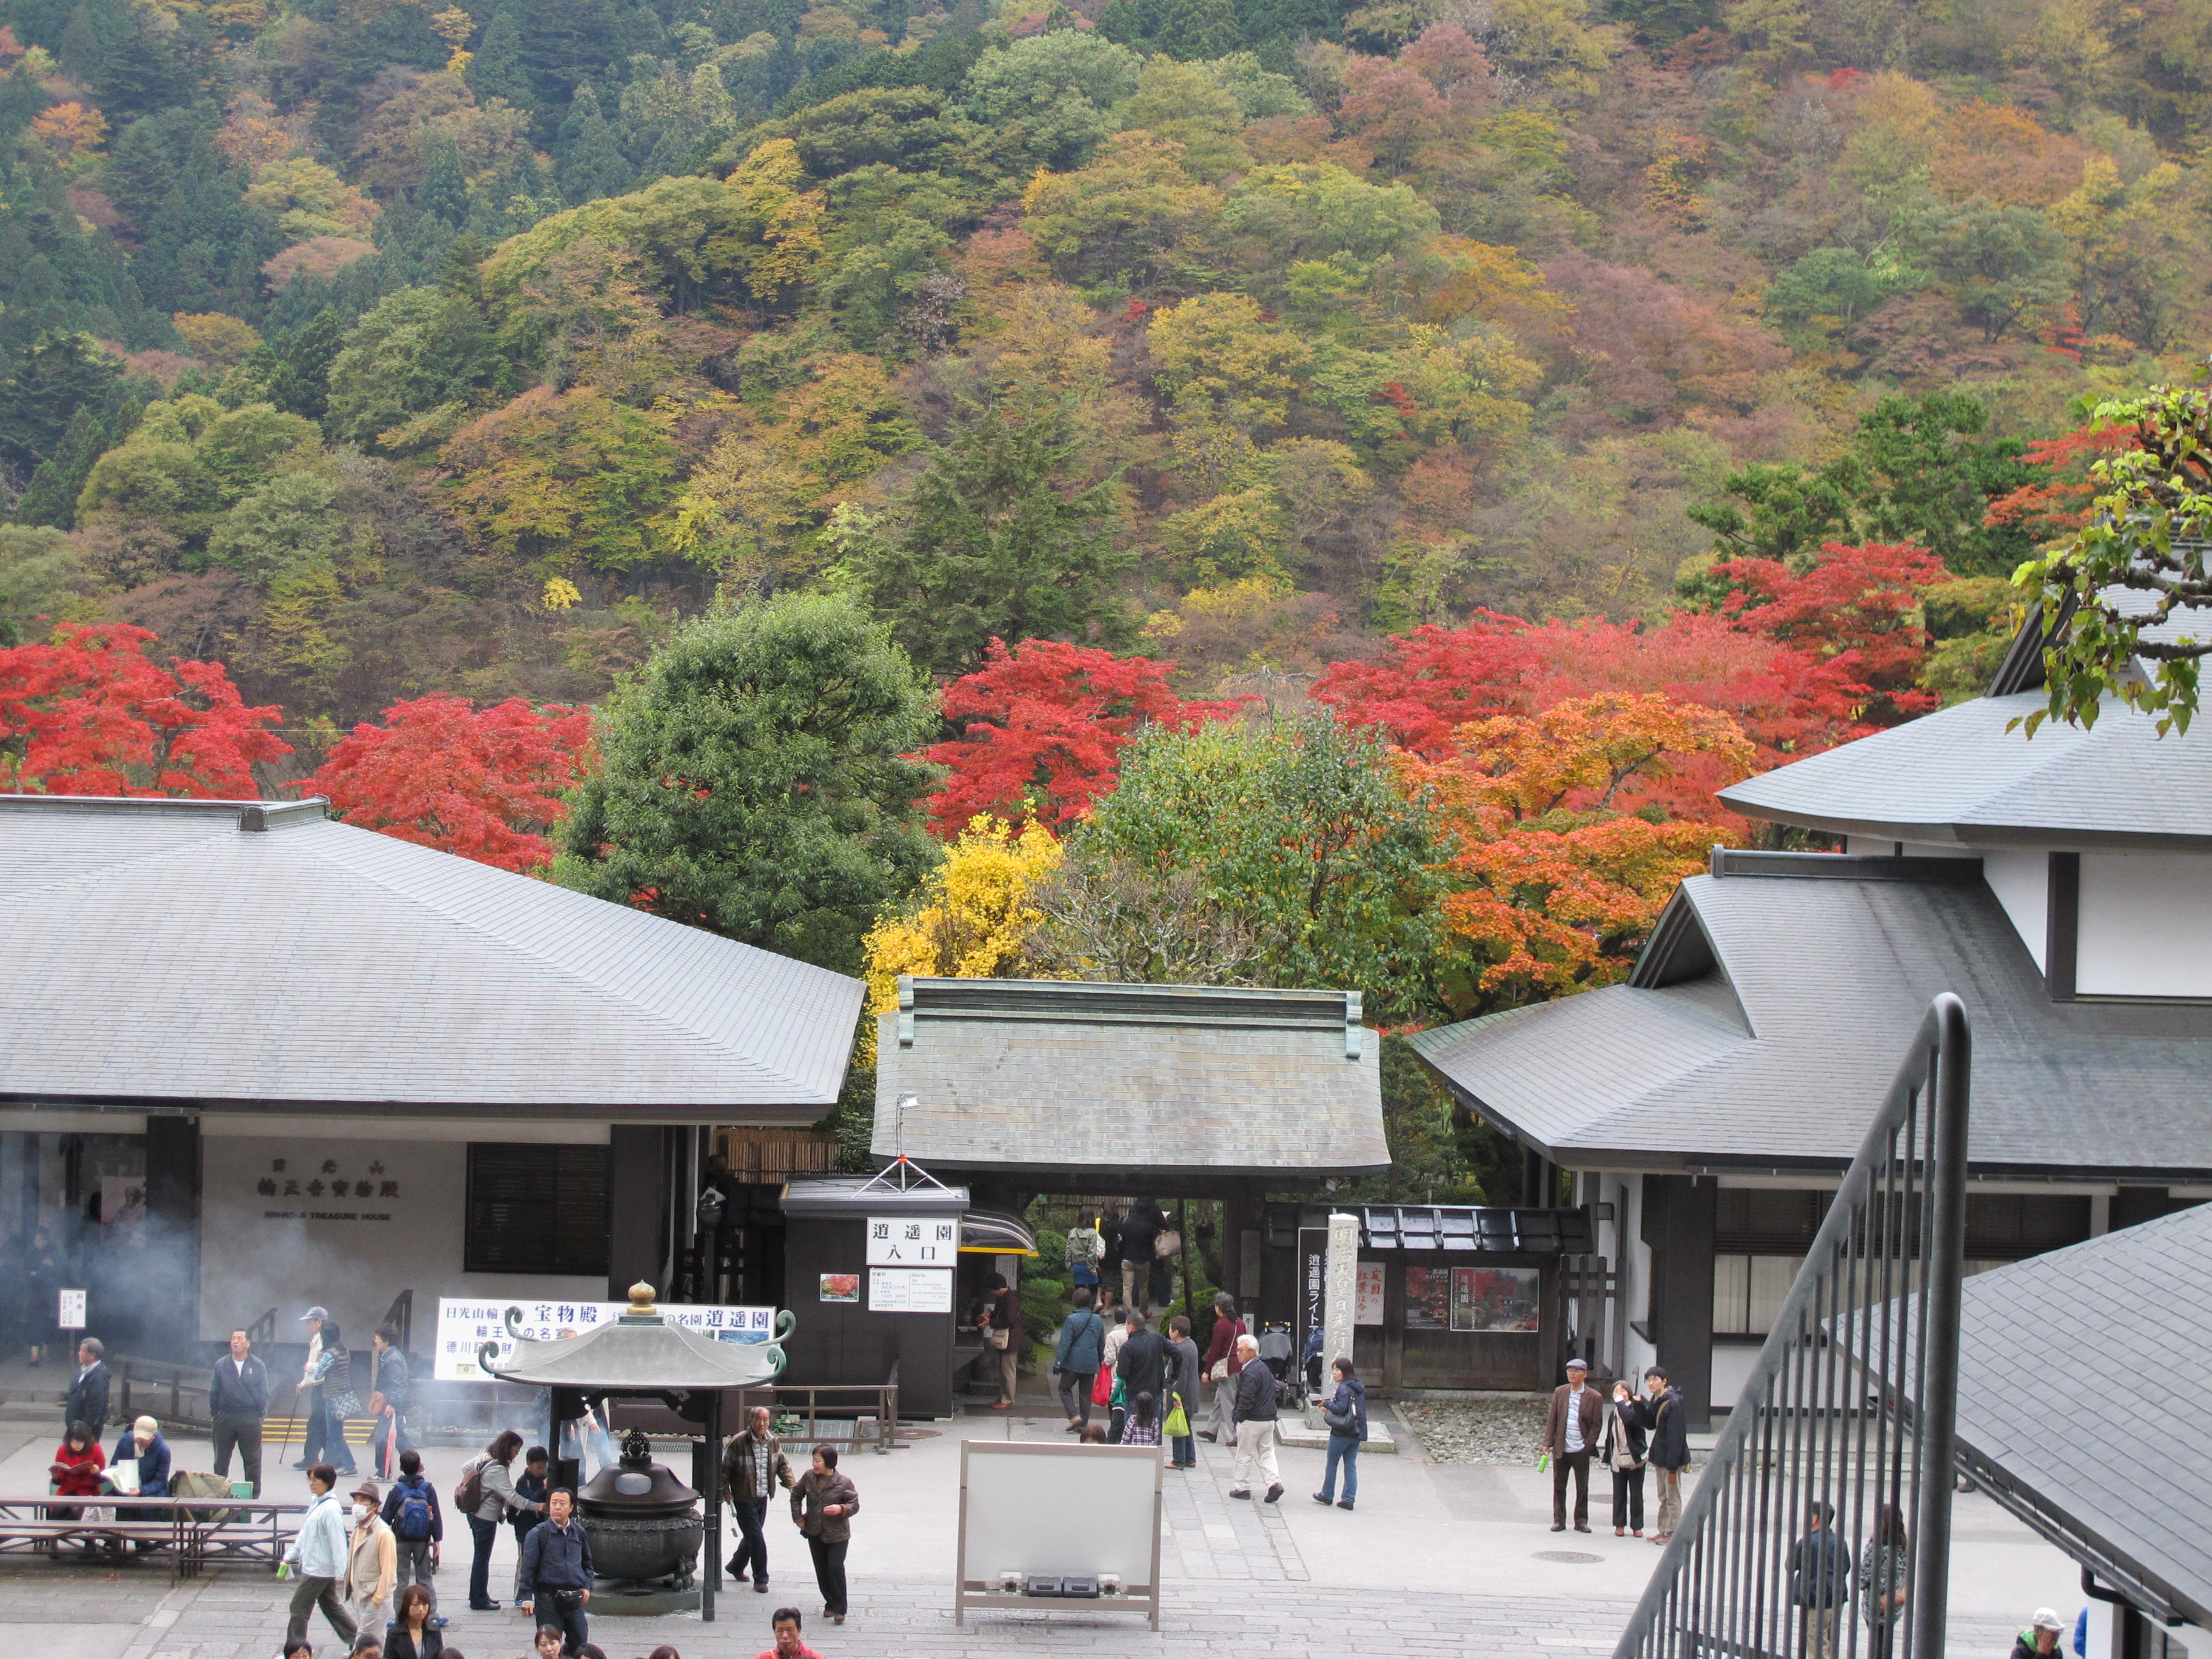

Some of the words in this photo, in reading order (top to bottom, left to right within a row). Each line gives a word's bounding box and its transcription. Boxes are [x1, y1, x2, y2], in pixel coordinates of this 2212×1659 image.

[873, 1223, 952, 1241] 逍遥園
[886, 1244, 936, 1260] 入口
[1308, 1254, 1321, 1335] 逍遥園ライト
[1371, 1268, 1383, 1304] 庭園の
[535, 1304, 598, 1324] 宝物殿
[705, 1310, 769, 1329] 逍遥園
